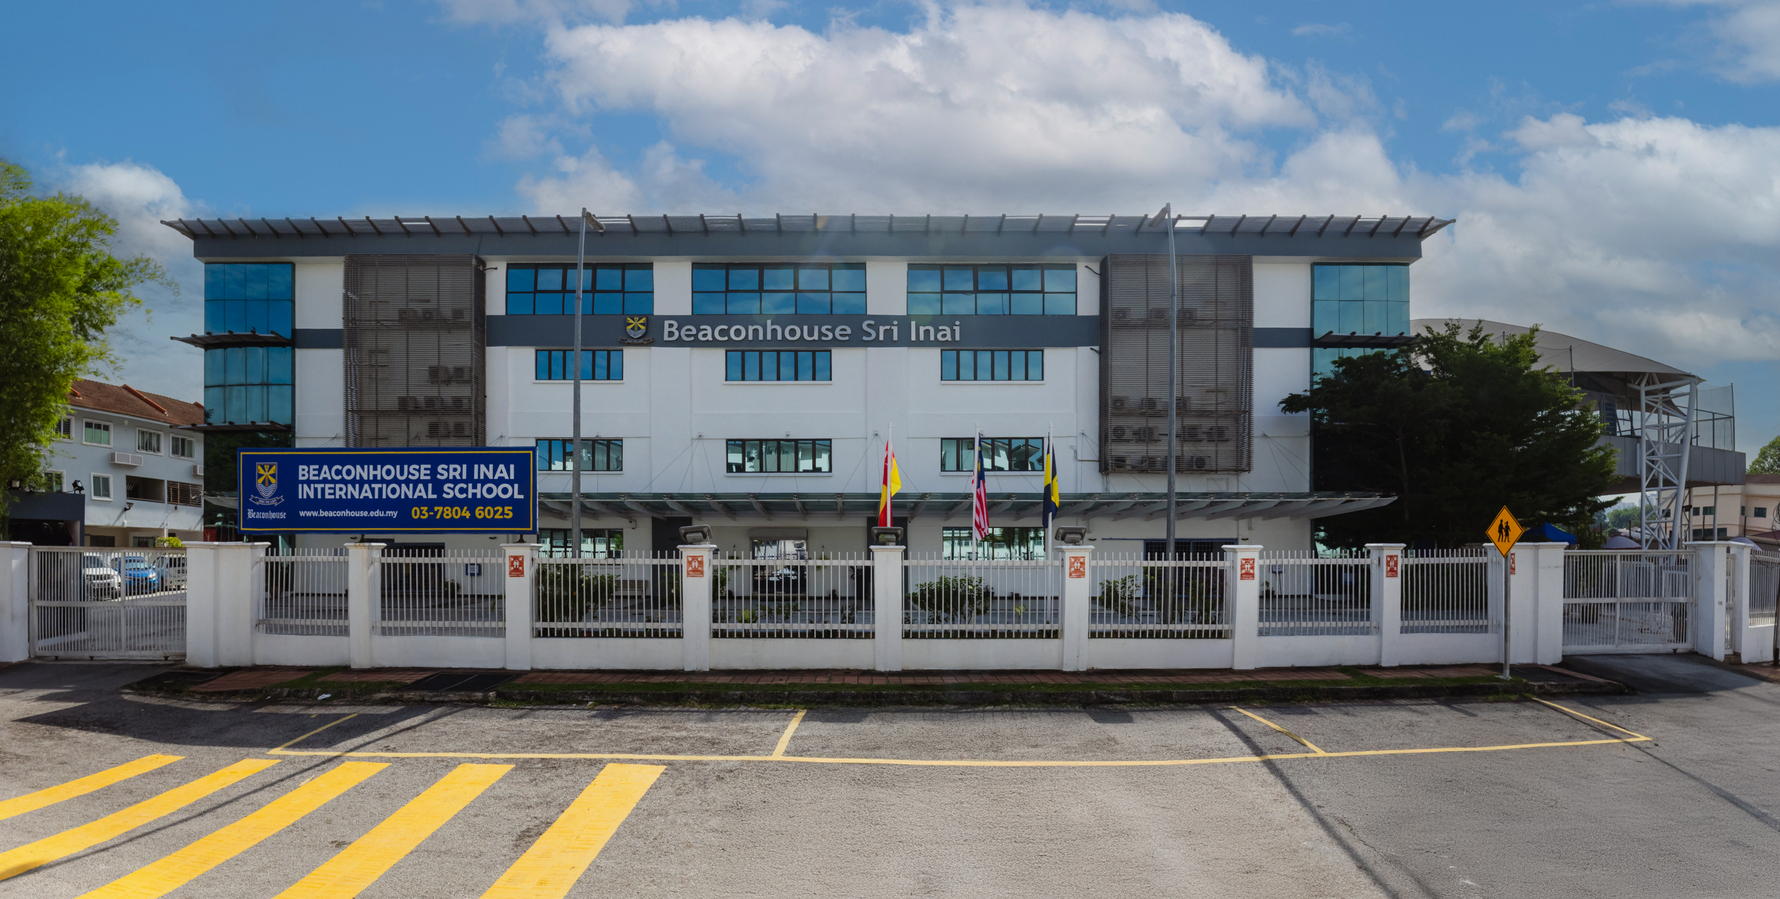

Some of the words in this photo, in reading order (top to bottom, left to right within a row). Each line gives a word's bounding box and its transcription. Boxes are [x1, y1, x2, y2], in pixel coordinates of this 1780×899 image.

[663, 319, 852, 342] Beaconhouse
[862, 319, 898, 342] Sri
[910, 319, 961, 342] Inai
[298, 464, 431, 481] BEACONHOUSE
[436, 464, 467, 480] SRI
[473, 463, 515, 480] INAI
[298, 483, 437, 499] INTERNATIONAL
[442, 483, 525, 499] SCHOOL
[247, 508, 287, 520] Beaconhouse
[299, 508, 398, 519] www.beaconhouse.edu.my
[411, 506, 471, 519] 03-7804
[475, 506, 513, 519] 6025
